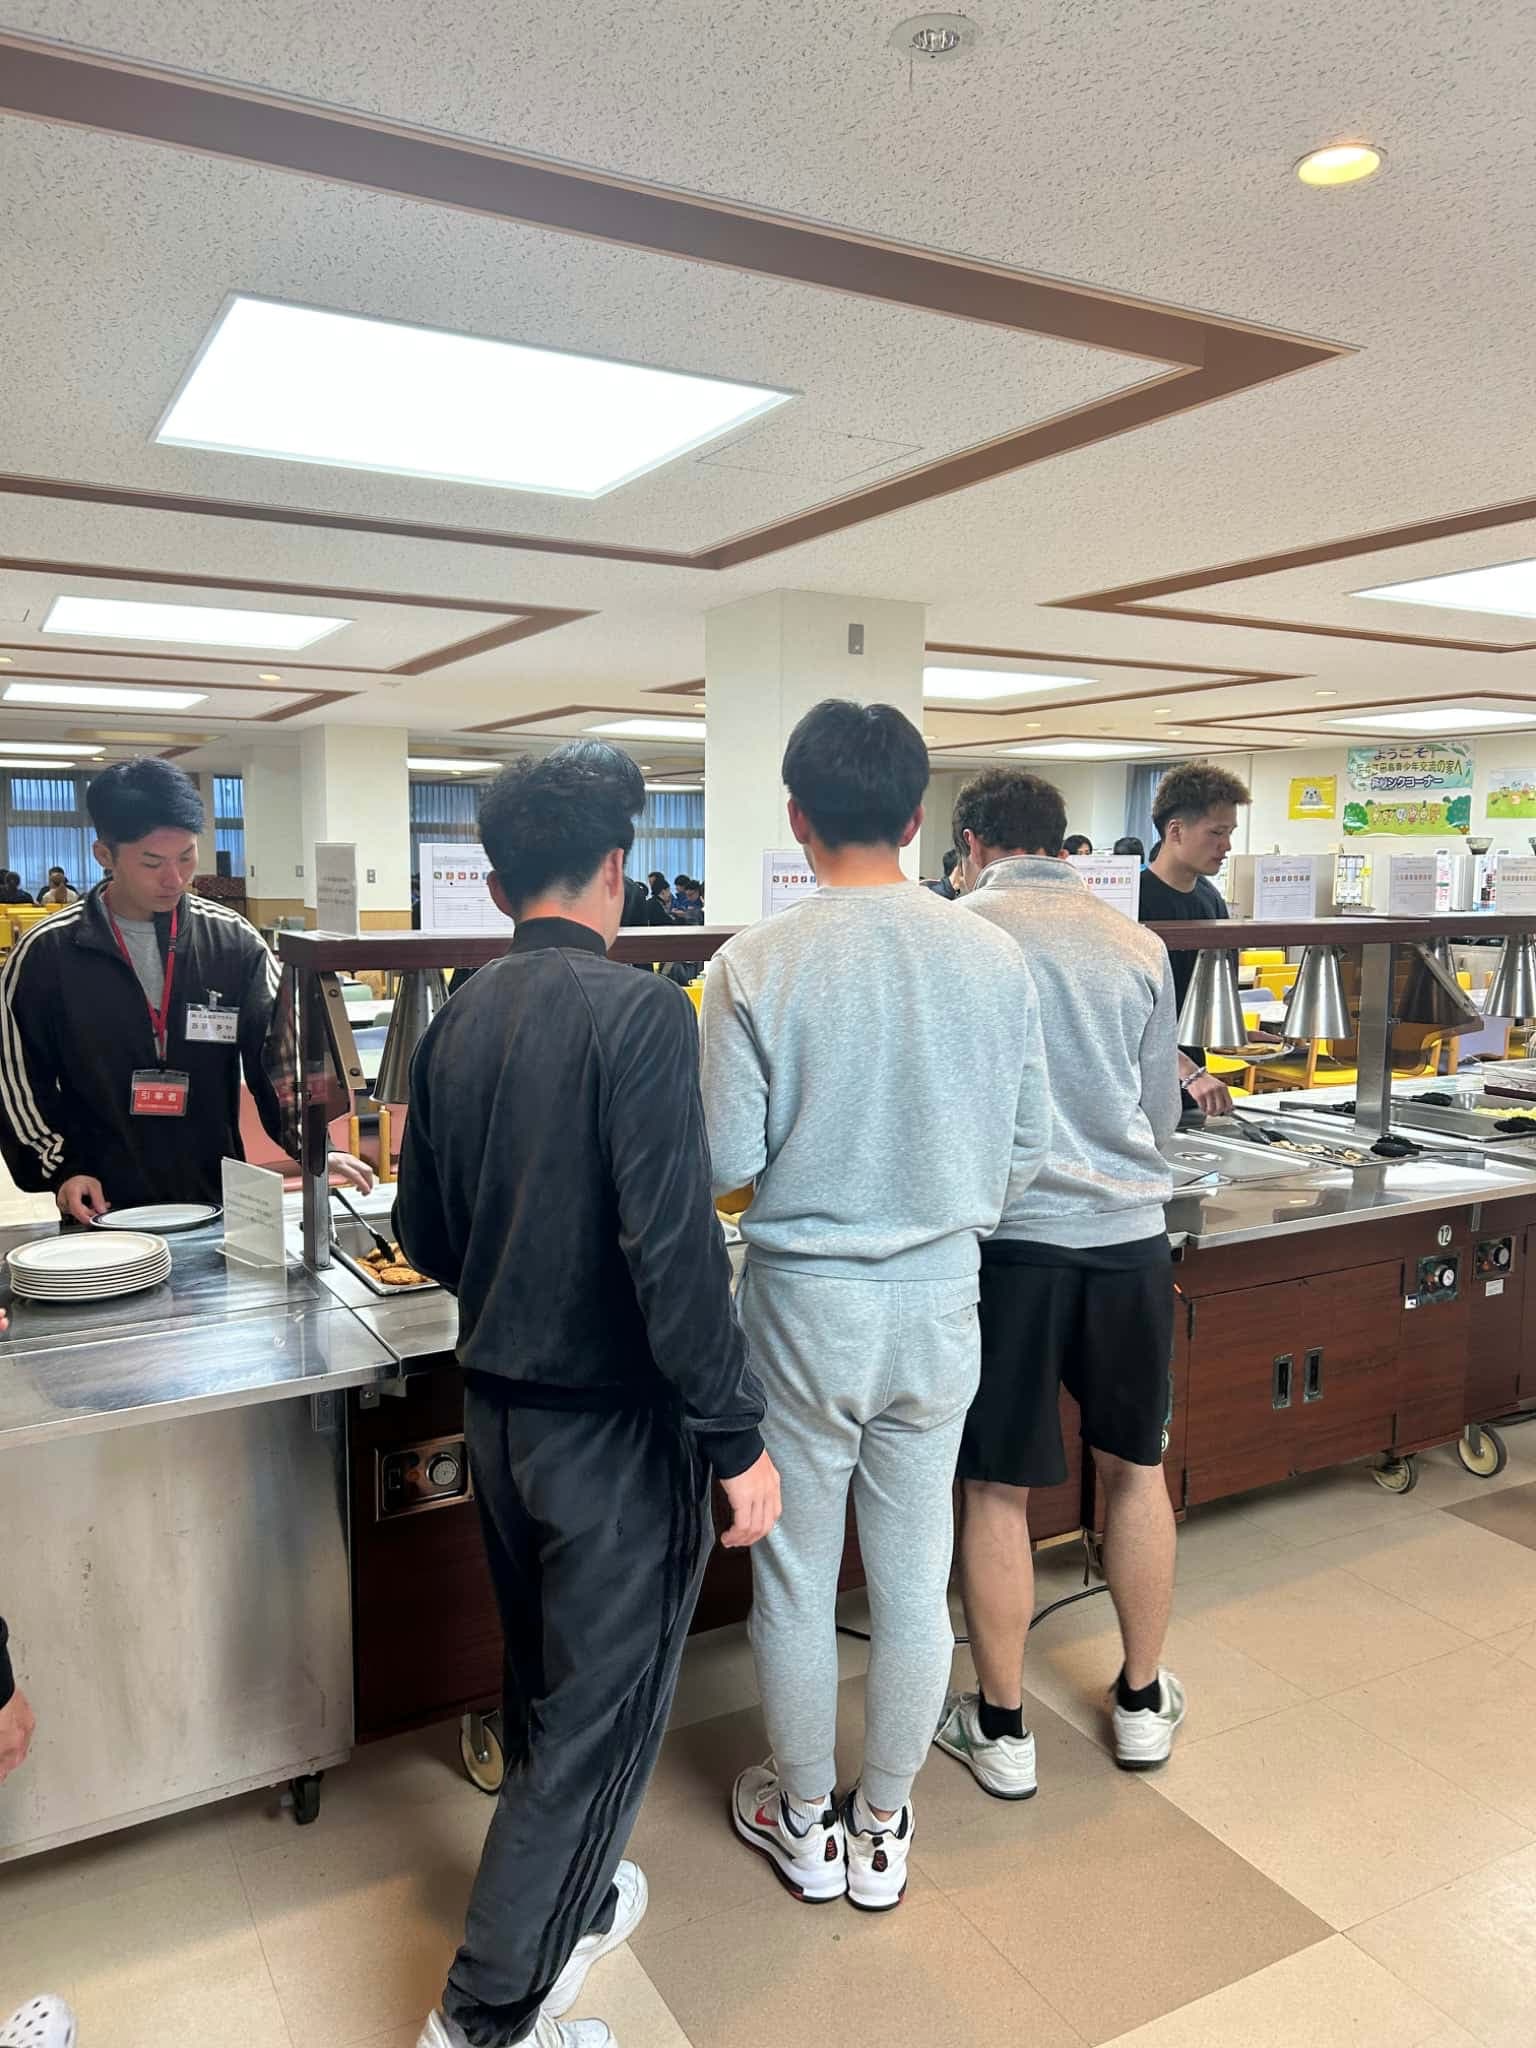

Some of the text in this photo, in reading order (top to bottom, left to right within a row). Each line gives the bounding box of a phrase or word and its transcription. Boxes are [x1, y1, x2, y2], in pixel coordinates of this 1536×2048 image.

[1371, 774, 1444, 790] ドリンクコーナー
